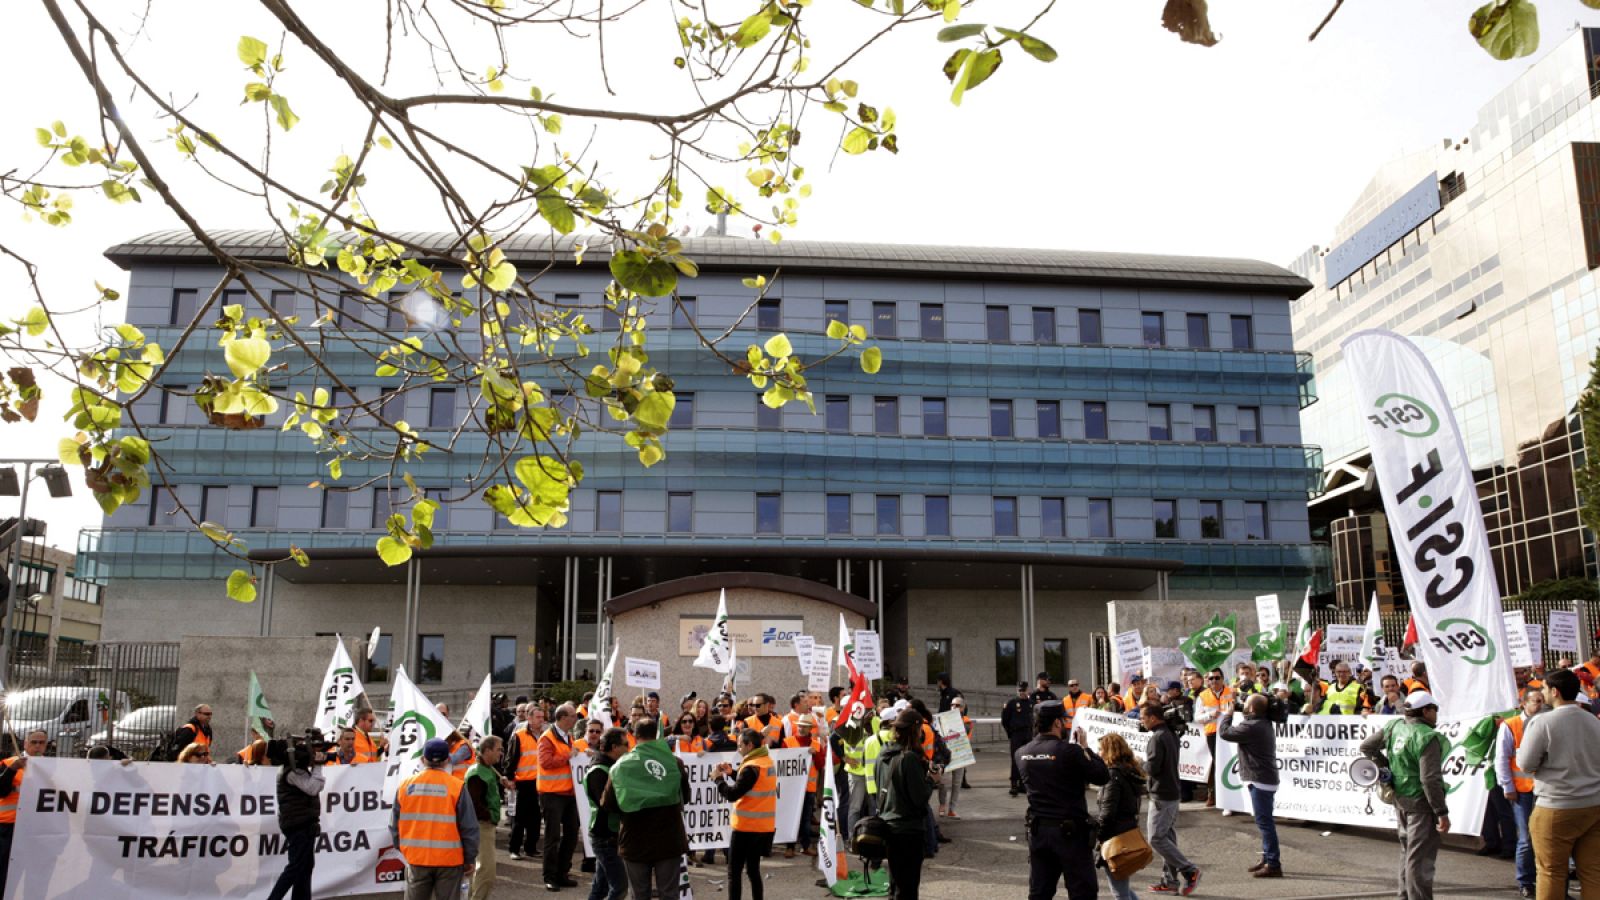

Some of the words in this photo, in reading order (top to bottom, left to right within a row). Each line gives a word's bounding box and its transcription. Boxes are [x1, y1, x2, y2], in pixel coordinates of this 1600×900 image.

[1275, 723, 1367, 741] MINADORES
[776, 754, 808, 777] MERÍA
[1275, 758, 1349, 775] DIGNIFICA
[1293, 778, 1342, 791] PUESTOS
[36, 788, 80, 813] EN
[90, 791, 230, 816] DEFENSA
[326, 786, 393, 814] PÚBL
[117, 830, 249, 857] TRÁFICO
[688, 831, 724, 844] XTRA
[378, 870, 403, 881] CGT
